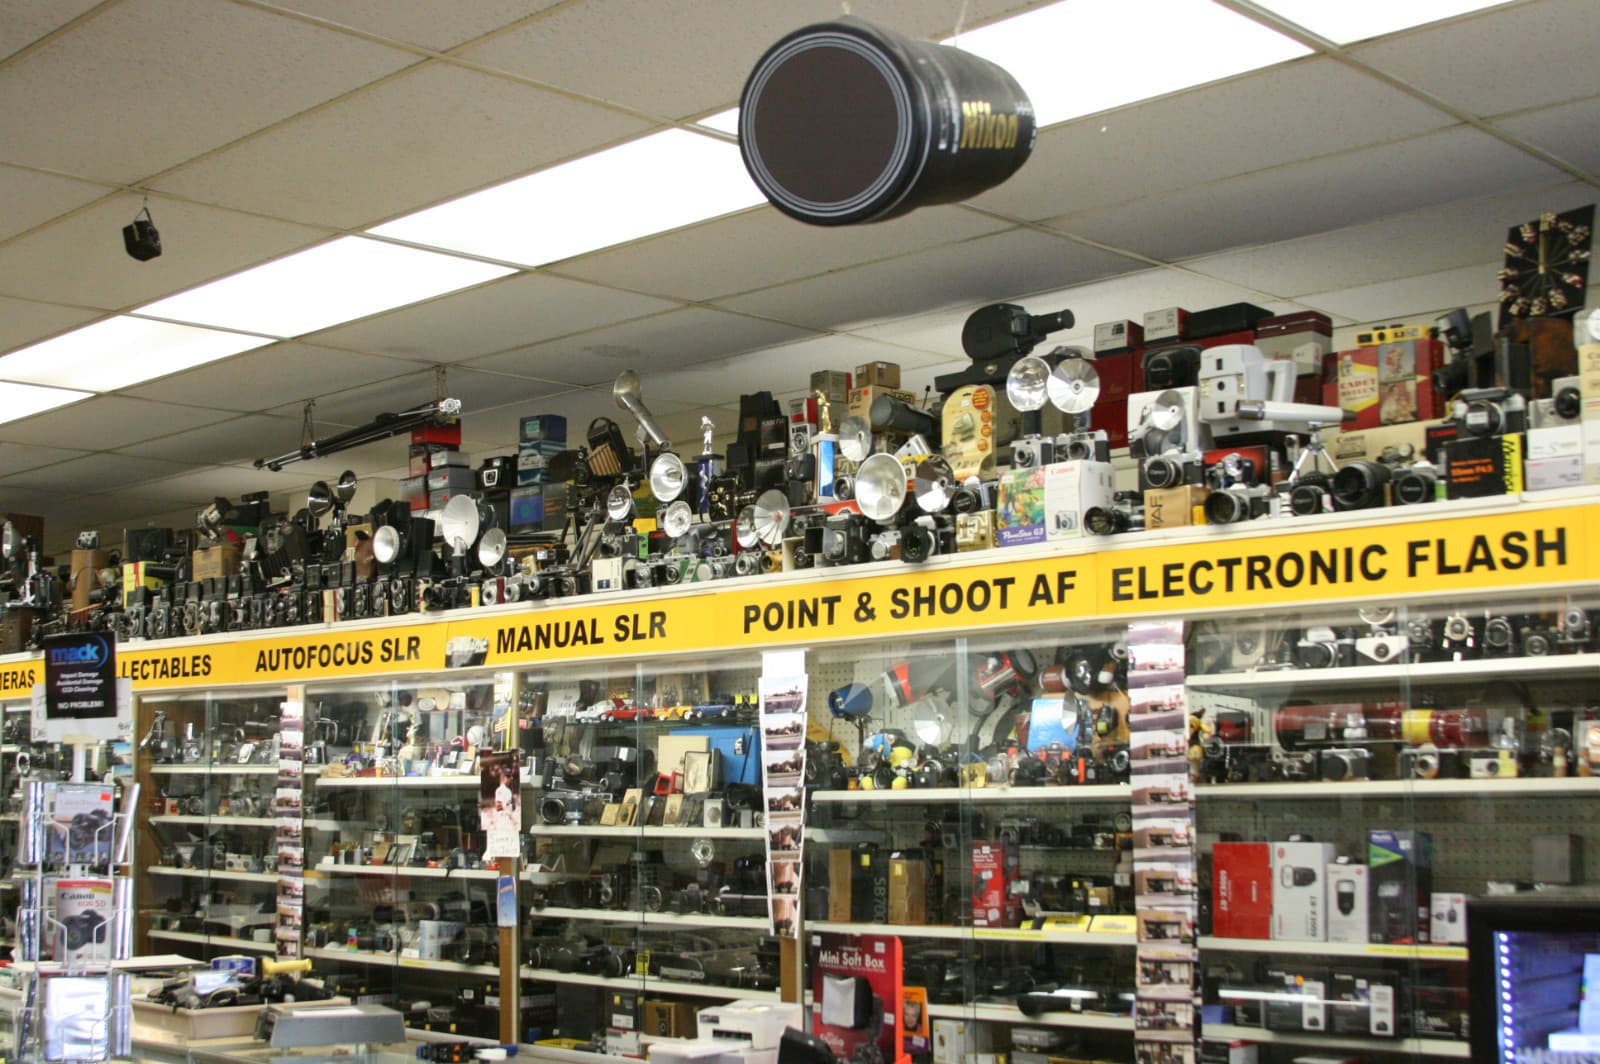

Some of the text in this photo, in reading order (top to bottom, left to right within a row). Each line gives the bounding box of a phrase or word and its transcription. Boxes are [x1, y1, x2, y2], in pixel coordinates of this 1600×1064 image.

[960, 101, 1018, 149] Nikon
[1113, 528, 1567, 602] ELECTRONIC FLASH
[744, 570, 1077, 634] POINT & SHOOT AF
[496, 611, 667, 654] MANUAL SLR
[51, 643, 99, 662] mack
[256, 636, 420, 673] AUTOFOCUS SLR
[78, 671, 99, 679] Damage
[117, 654, 212, 680] LECTABLES
[57, 702, 69, 710] NO
[61, 892, 95, 900] Canon
[819, 949, 885, 968] Mini Soft Box
